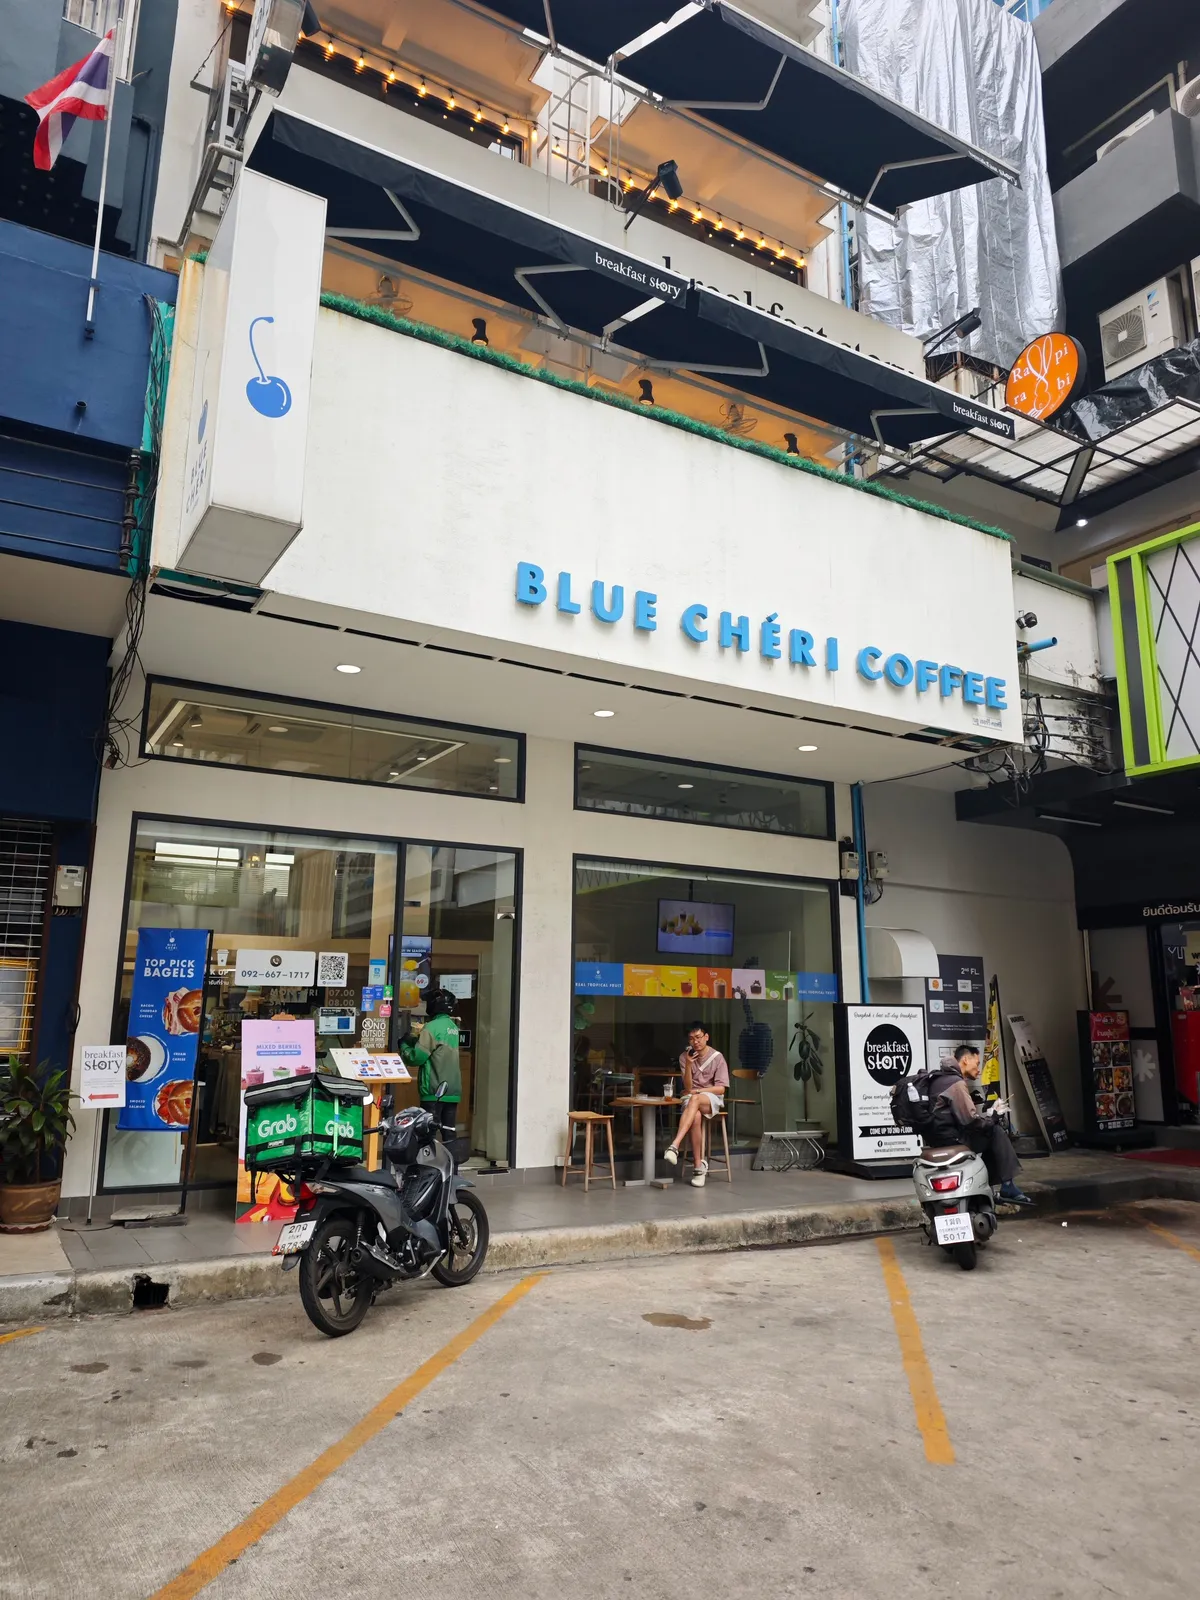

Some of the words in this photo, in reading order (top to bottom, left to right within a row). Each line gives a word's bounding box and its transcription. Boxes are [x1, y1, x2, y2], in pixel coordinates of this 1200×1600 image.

[594, 252, 647, 285] breakfast
[649, 275, 681, 300] story
[1012, 365, 1031, 383] Ra
[1054, 343, 1069, 365] pi
[1013, 391, 1027, 405] ra
[1056, 373, 1071, 390] bi
[953, 402, 988, 425] breakfast
[989, 418, 1011, 435] story
[516, 560, 658, 632] BLUE
[681, 603, 839, 672] CHÉRI
[857, 646, 1008, 711] COFFEE
[145, 959, 166, 968] TOP
[169, 959, 196, 968] PICK
[143, 967, 195, 978] BAGELS
[241, 970, 310, 979] 092-667-1717
[329, 989, 355, 997] 07.00
[328, 999, 355, 1007] 08.00
[373, 1021, 386, 1030] NO
[361, 1029, 386, 1038] OUTSIDE
[866, 1040, 910, 1053] breakfast
[84, 1050, 124, 1060] breakfast
[84, 1059, 123, 1074] story
[867, 1052, 910, 1076] story
[258, 1114, 297, 1138] Grab
[325, 1120, 354, 1138] Gab
[869, 1127, 881, 1135] COME
[880, 1127, 887, 1135] UP
[886, 1126, 893, 1134] TO
[900, 1126, 913, 1134] FLOOR
[943, 1232, 966, 1241] 5017
